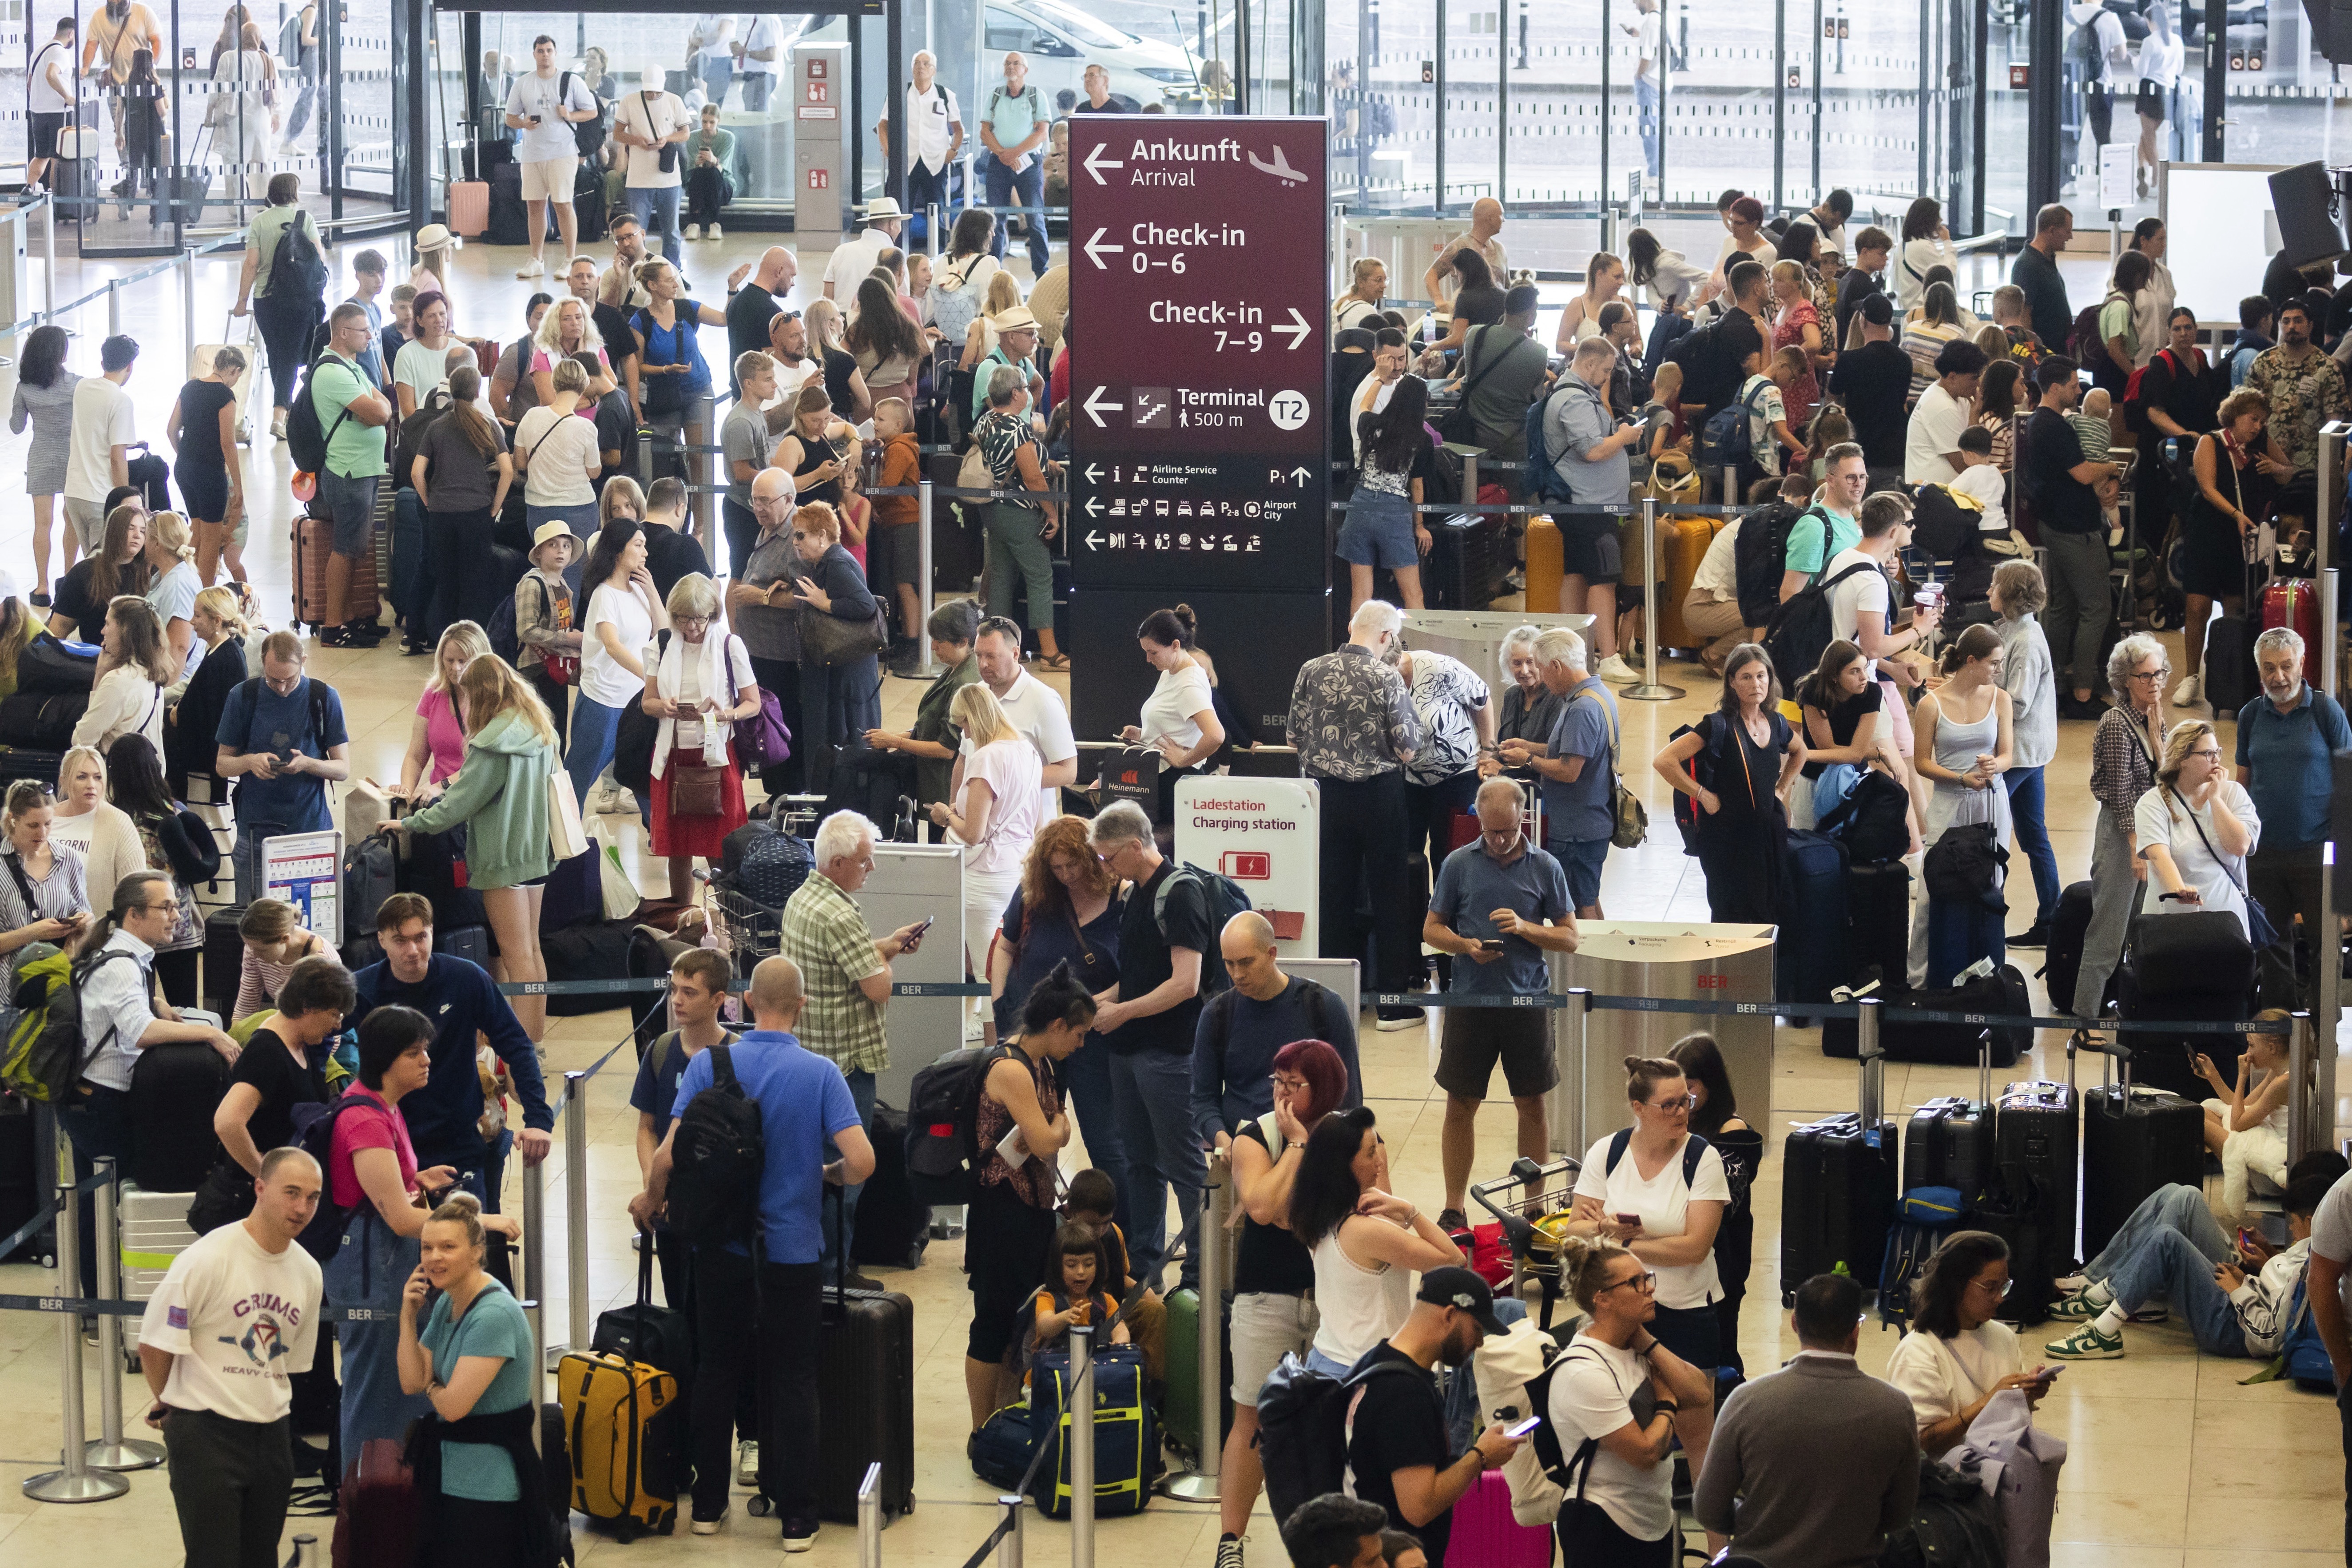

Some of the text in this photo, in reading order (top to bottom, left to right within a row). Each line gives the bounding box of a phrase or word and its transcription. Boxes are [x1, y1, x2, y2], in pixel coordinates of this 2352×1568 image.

[1131, 138, 1241, 162] Ankunft
[1131, 168, 1196, 186] Arrival
[1132, 222, 1245, 246] Check-in
[1434, 243, 1445, 252] BE
[1149, 300, 1262, 324] Check-in
[1177, 388, 1303, 420] Terminal T2
[1195, 413, 1243, 427] 500 m
[1152, 465, 1217, 475] Airline Service
[1152, 476, 1188, 484] Counter
[1264, 500, 1297, 511] Airport
[1264, 511, 1282, 521] City
[1263, 715, 1287, 726] BER
[1108, 782, 1149, 794] Heinemann
[1193, 798, 1266, 812] Ladestation
[1193, 817, 1296, 832] Charging station
[654, 979, 667, 988] BE
[1698, 975, 1728, 988] BER
[525, 983, 545, 993] BER
[901, 985, 922, 995] BER
[1380, 994, 1400, 1004] BER
[1513, 996, 1533, 1005] BER
[1736, 1004, 1757, 1013] BER
[1965, 1014, 1986, 1023] BER
[2235, 1023, 2256, 1032] BER
[39, 1298, 64, 1310] BER
[348, 1308, 372, 1320] BER
[223, 1366, 261, 1377] HEAVY
